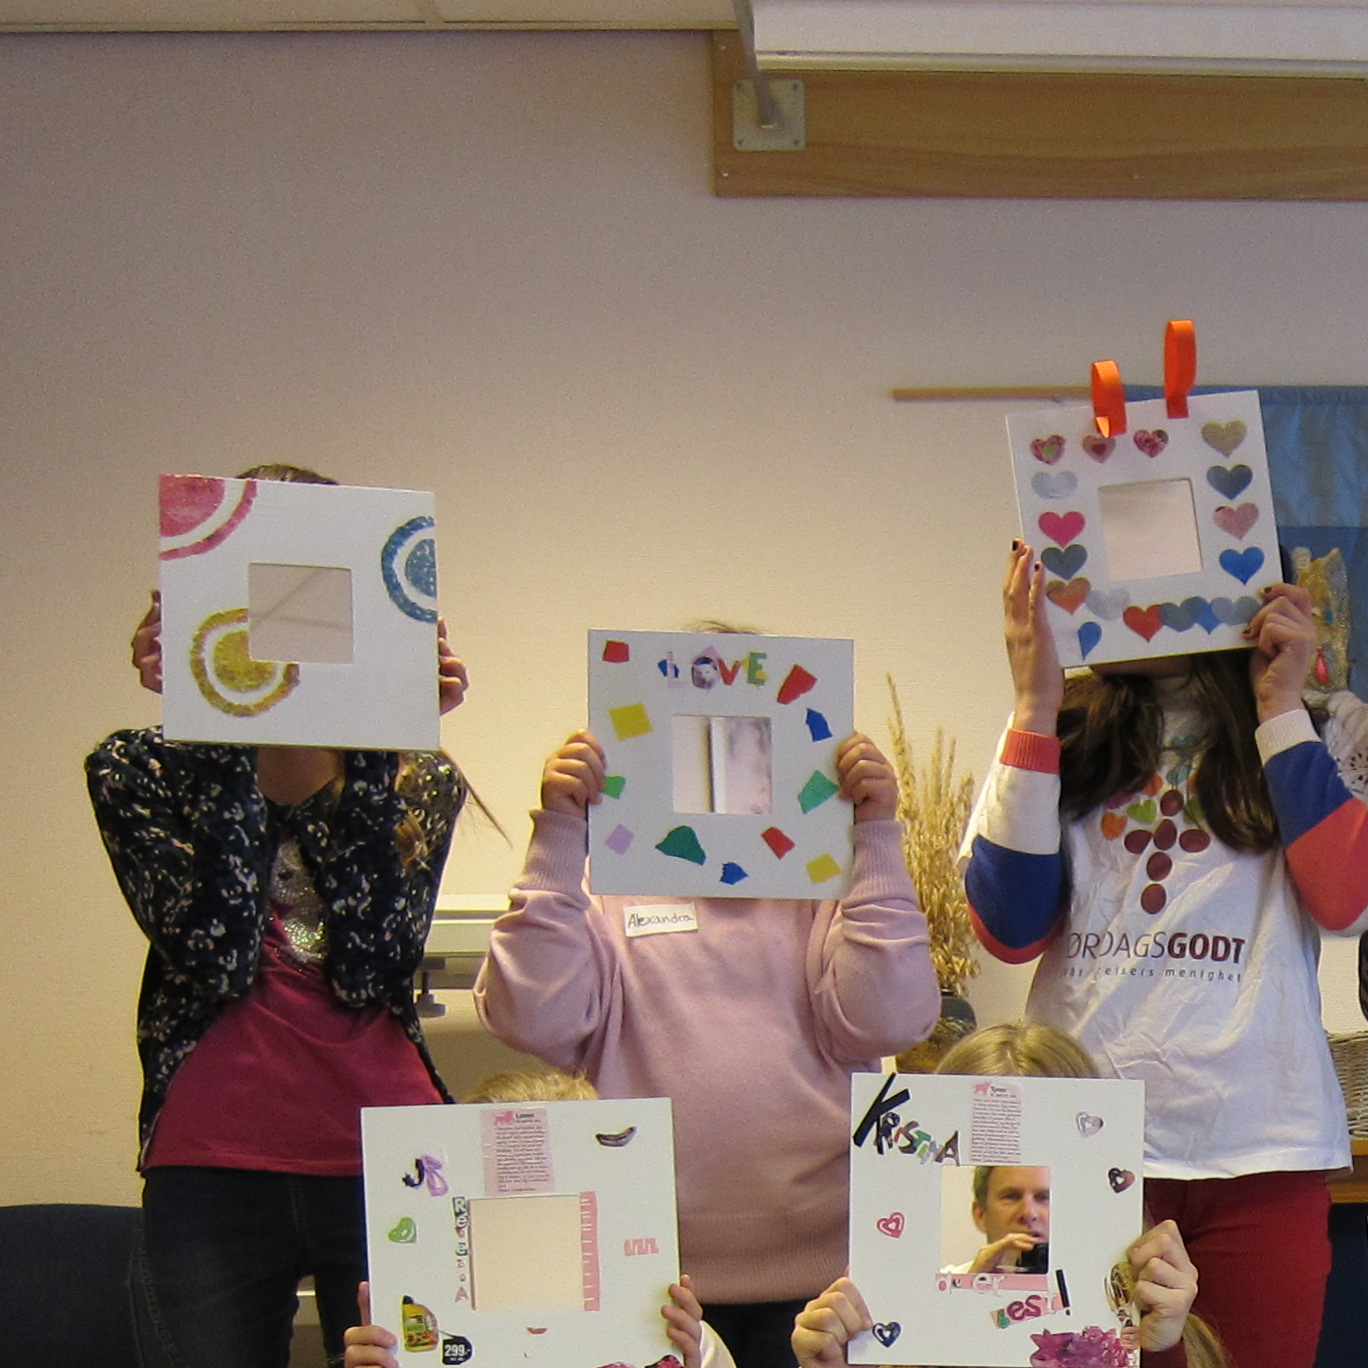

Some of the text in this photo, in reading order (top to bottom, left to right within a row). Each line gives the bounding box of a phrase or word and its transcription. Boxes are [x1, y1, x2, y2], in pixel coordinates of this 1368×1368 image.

[664, 650, 768, 690] LOVE
[1067, 932, 1246, 964] ØRDAGSGODT
[1164, 967, 1243, 982] menighet
